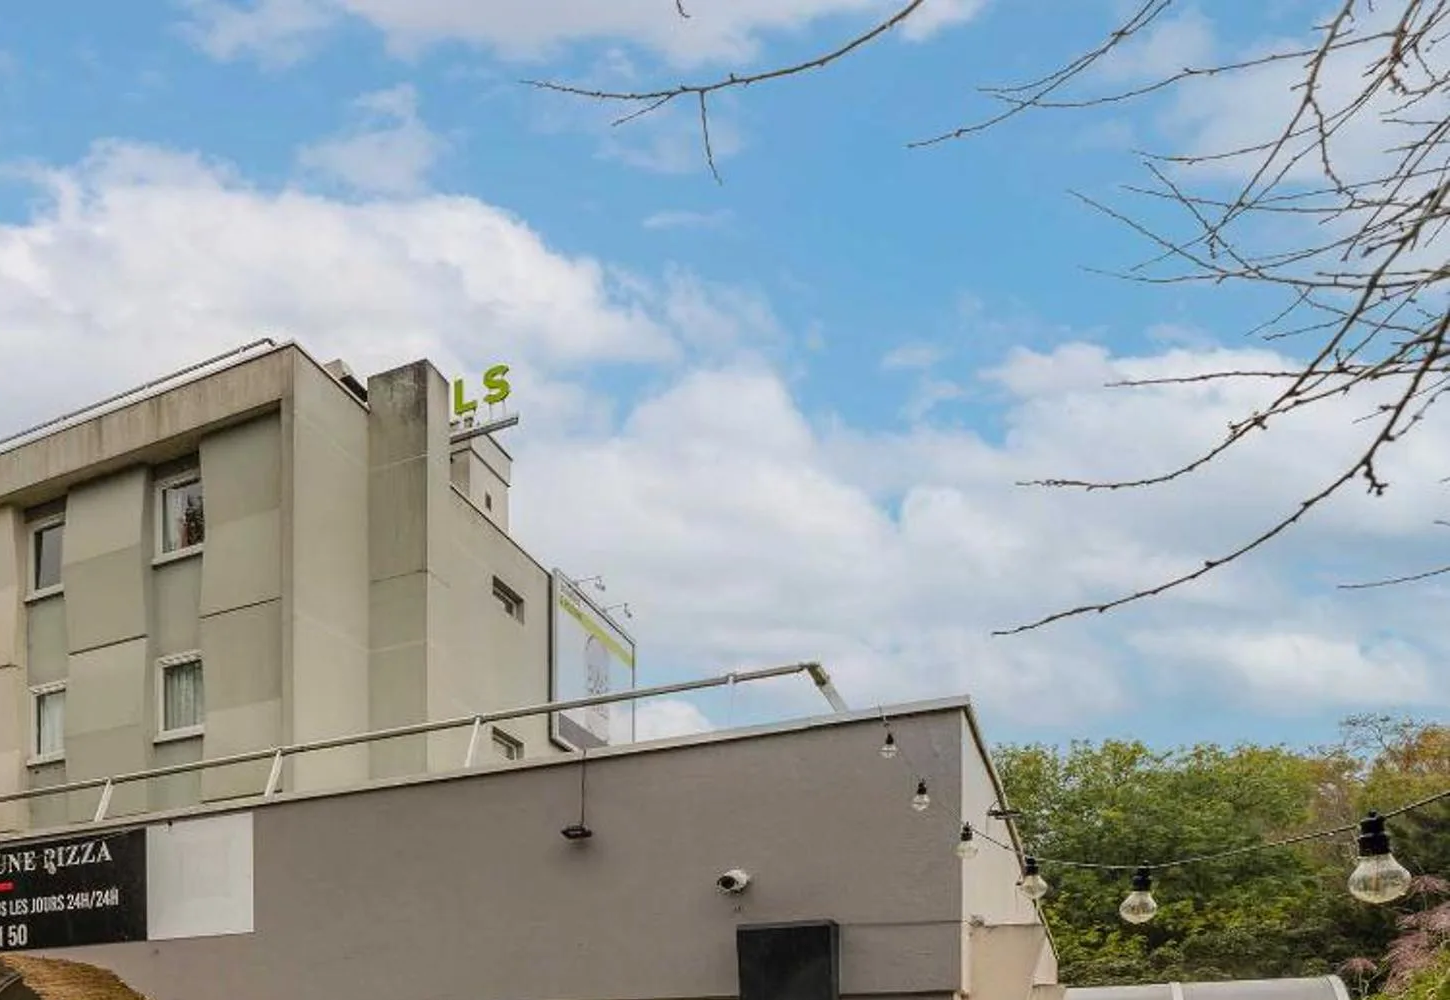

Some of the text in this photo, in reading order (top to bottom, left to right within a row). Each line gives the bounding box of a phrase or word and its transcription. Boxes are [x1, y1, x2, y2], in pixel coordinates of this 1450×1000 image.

[454, 364, 511, 415] LS
[43, 840, 113, 869] PIZZA
[10, 898, 29, 916] LES
[31, 894, 65, 914] JOURS
[67, 888, 119, 910] 24H/24H
[7, 924, 28, 946] 50
